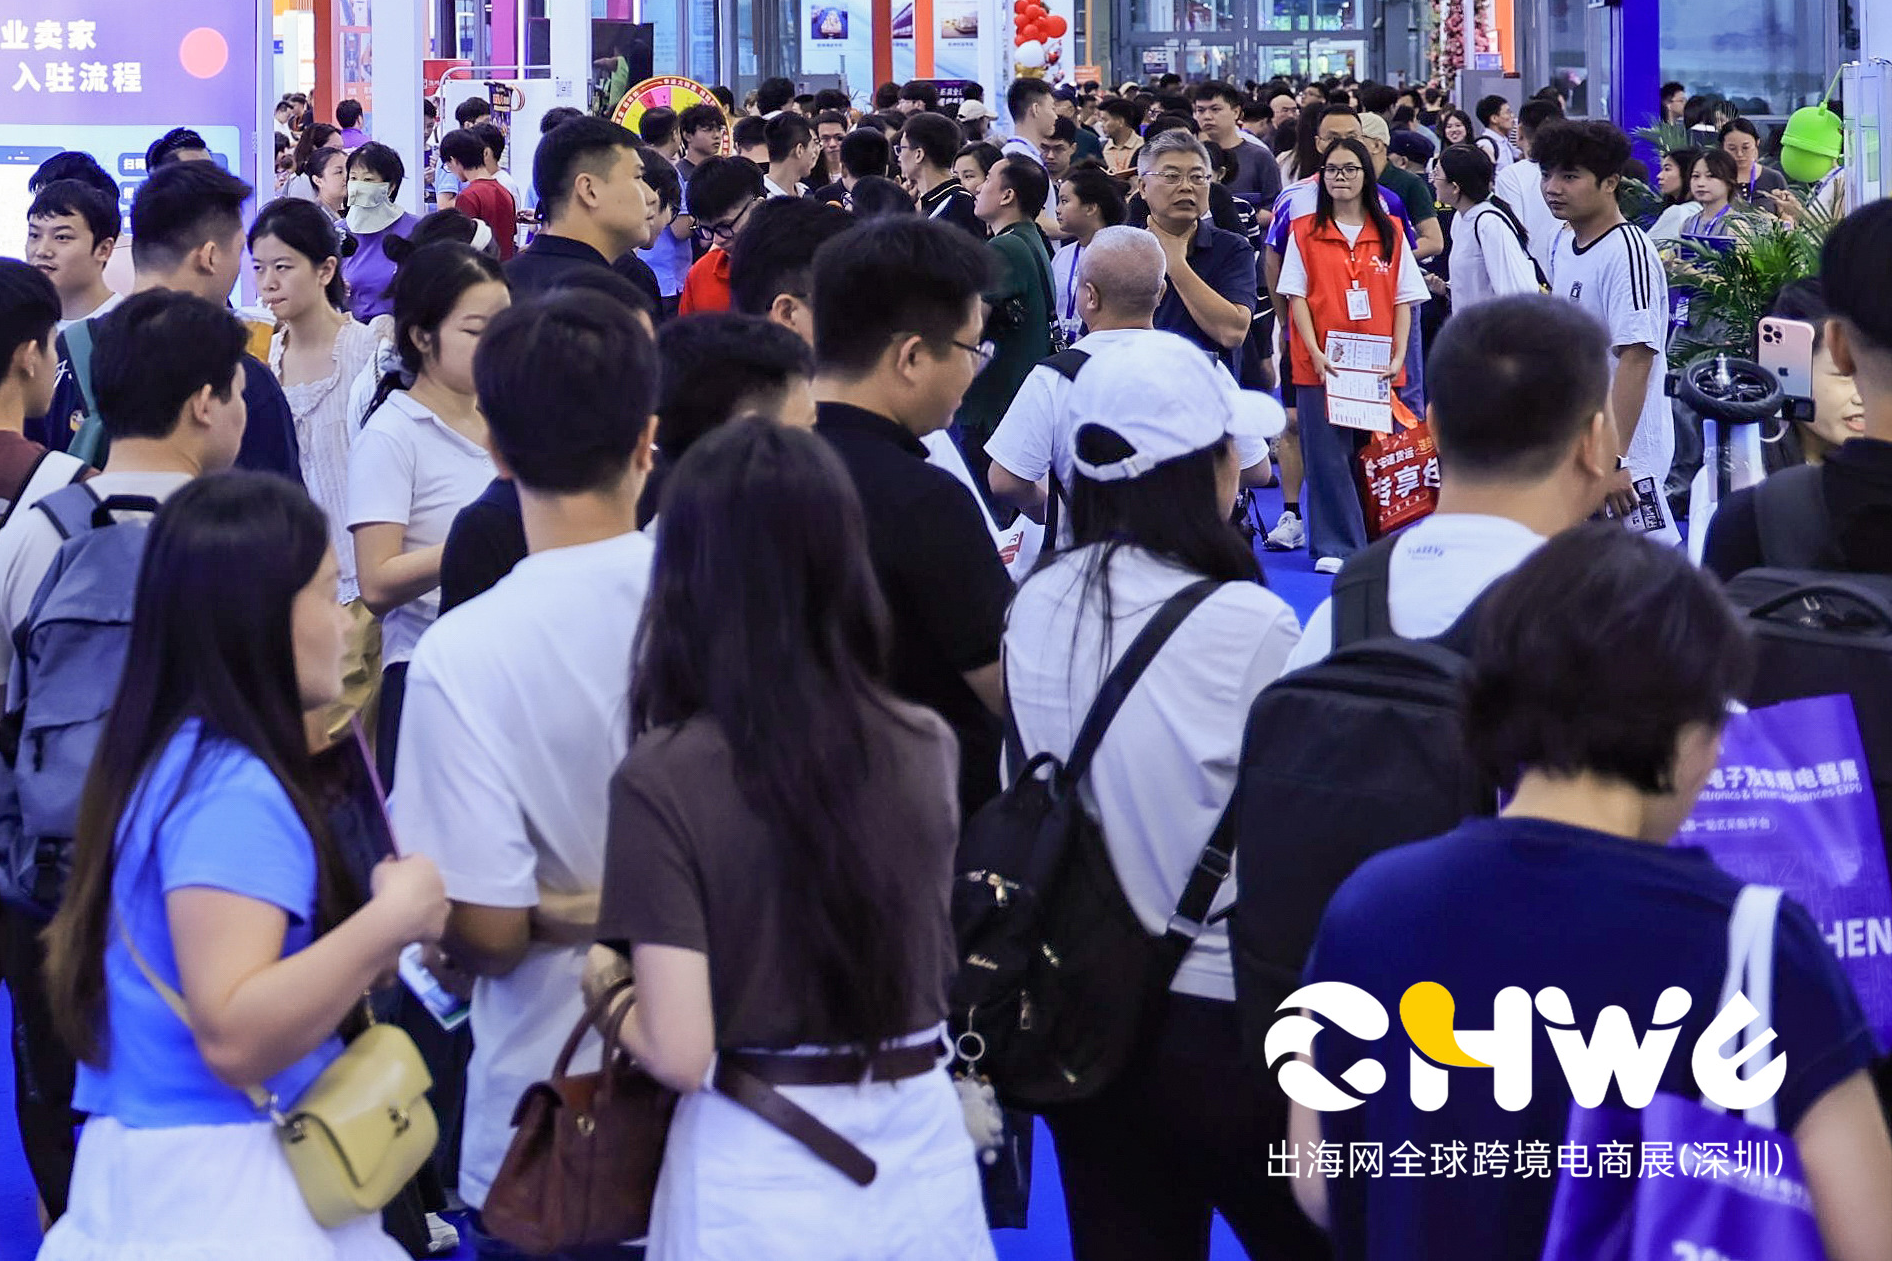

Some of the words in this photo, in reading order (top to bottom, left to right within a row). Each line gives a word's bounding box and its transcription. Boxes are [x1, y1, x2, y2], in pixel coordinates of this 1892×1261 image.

[11, 61, 143, 93] 入驻流程
[1371, 457, 1441, 506] 专享包
